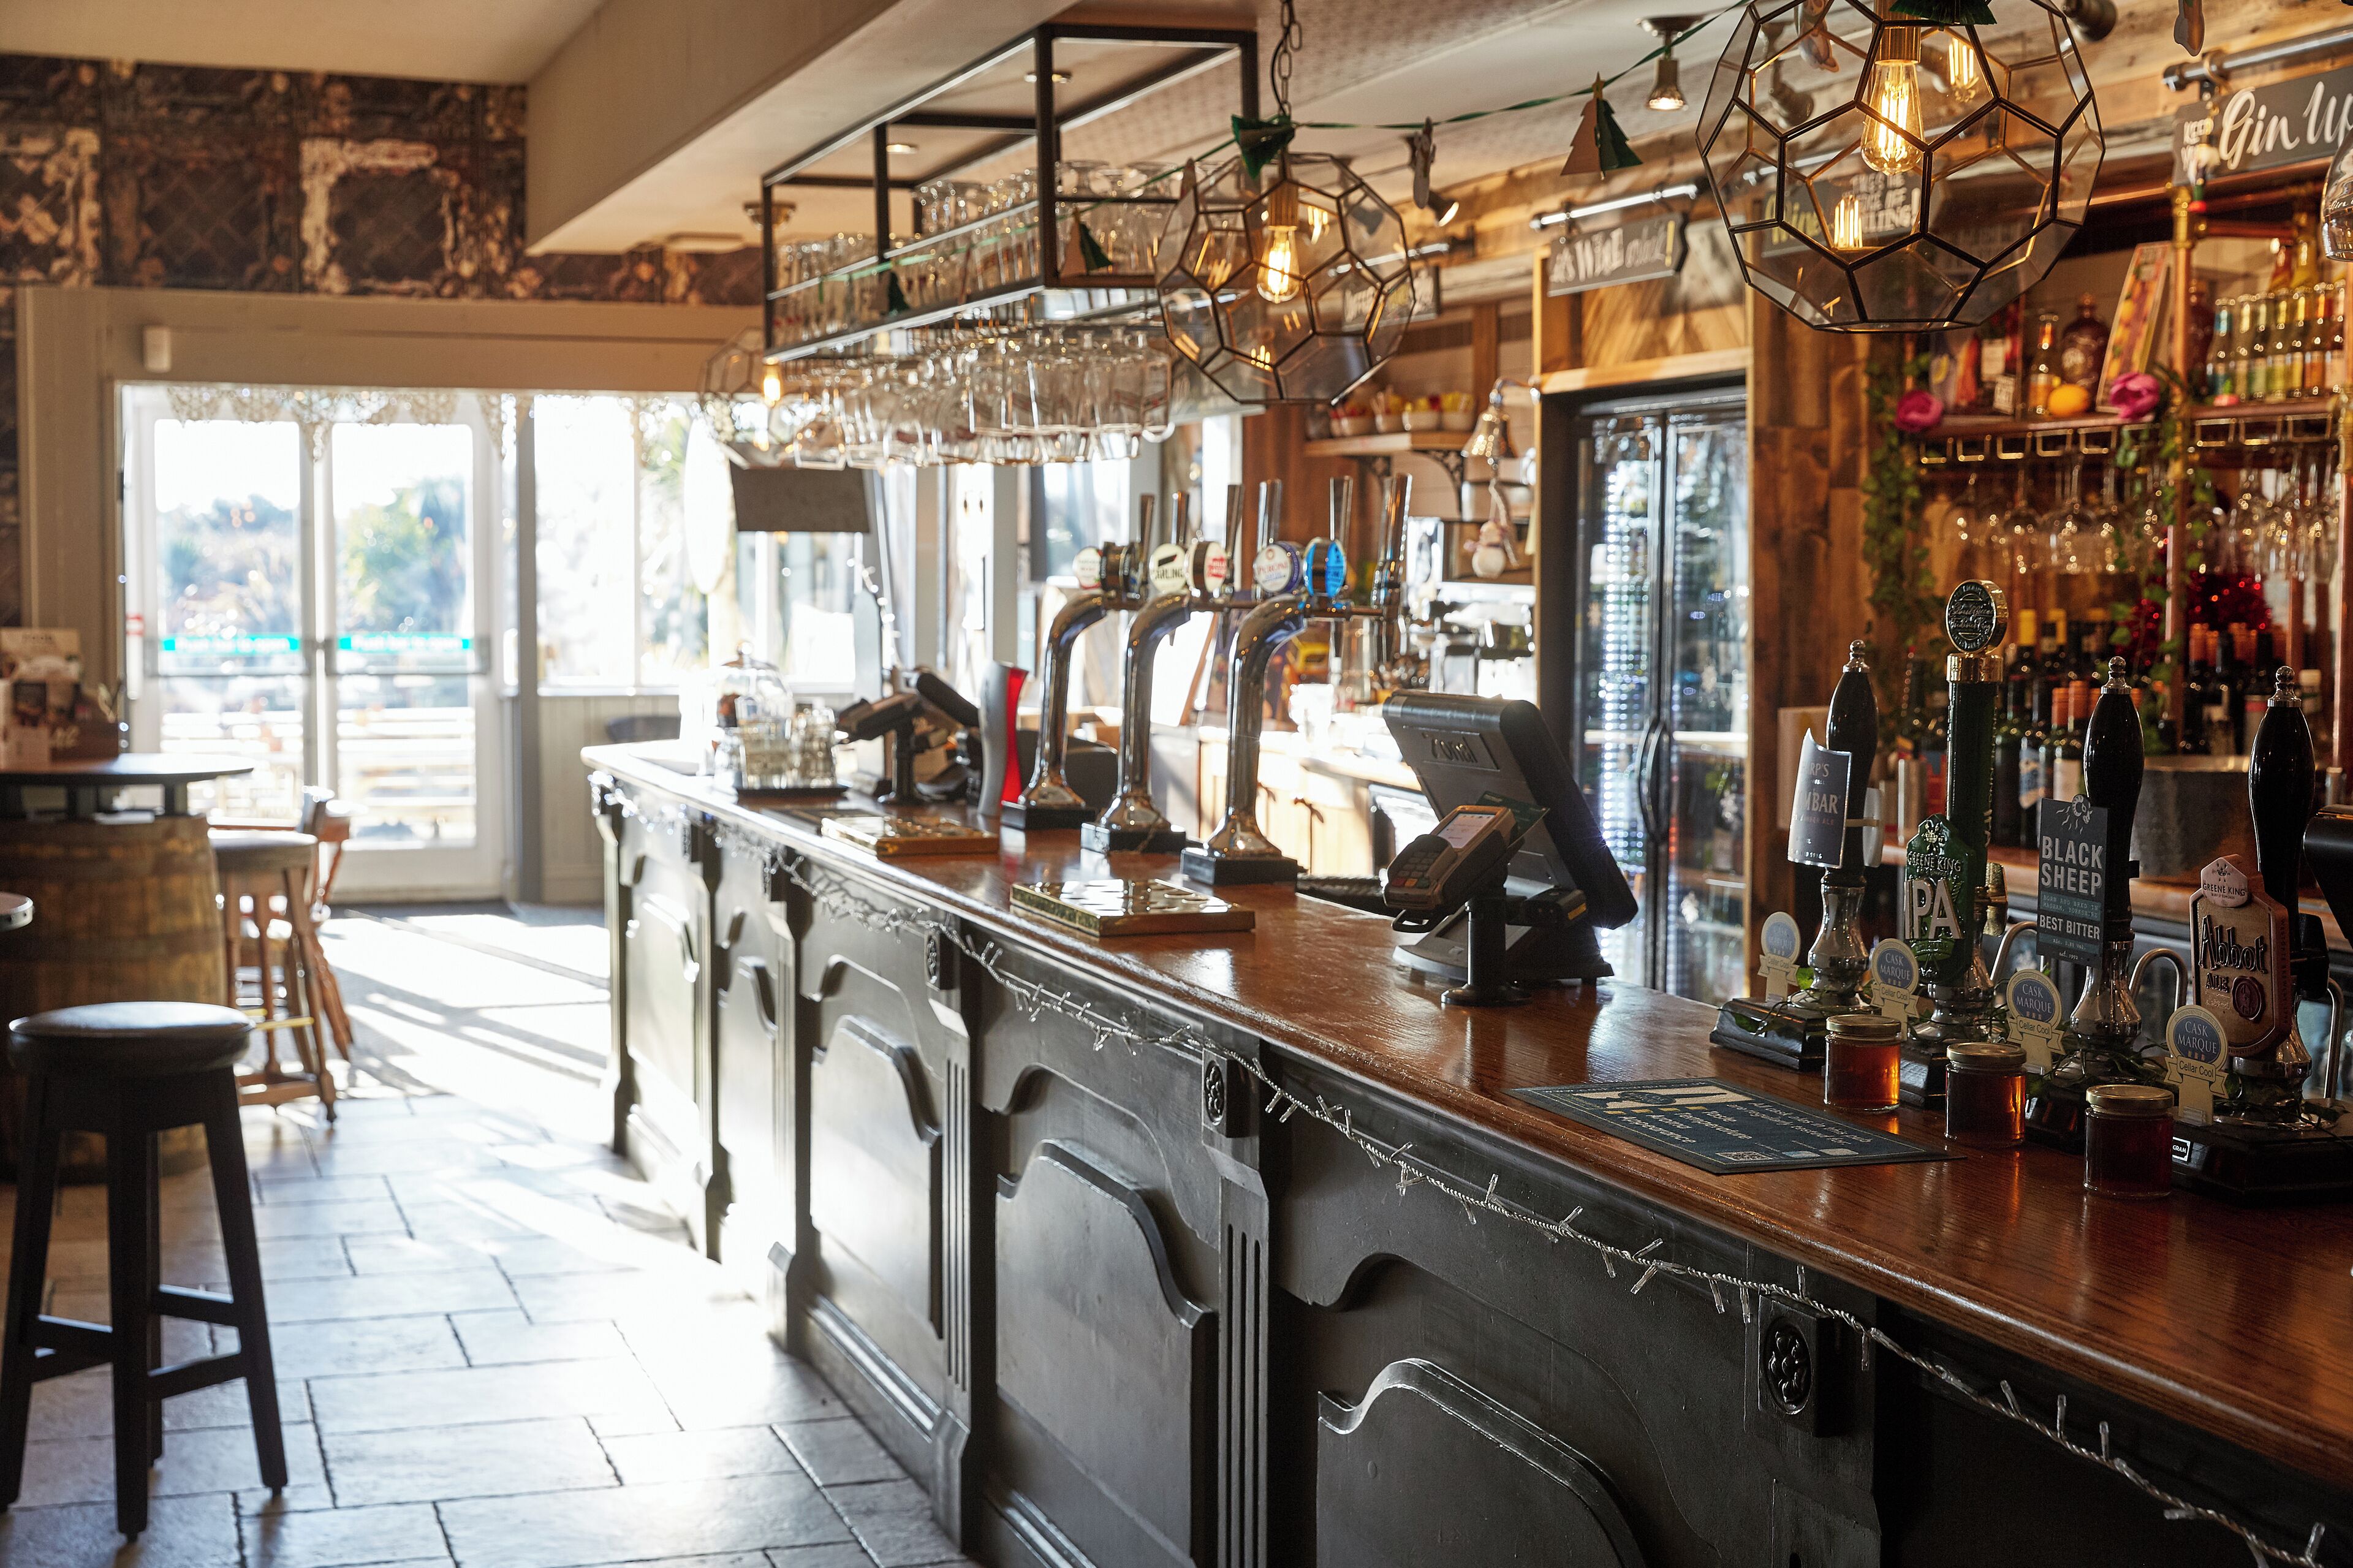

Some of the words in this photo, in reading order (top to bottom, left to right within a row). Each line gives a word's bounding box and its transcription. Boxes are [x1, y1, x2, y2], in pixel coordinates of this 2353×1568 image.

[2219, 86, 2300, 170] Gin
[1908, 850, 1935, 868] GREENE
[1937, 856, 1961, 872] KING
[2041, 835, 2104, 869] BLACK
[2040, 863, 2102, 896] SHEEP
[2203, 883, 2226, 893] GREENE
[2228, 887, 2246, 896] KING
[1904, 877, 1963, 939] IPA
[2039, 914, 2063, 931] BEST
[2066, 920, 2101, 941] BITTER
[2198, 914, 2268, 974] Abbot
[1885, 953, 1904, 966] CASK
[1880, 964, 1911, 980] MARQUE
[2022, 983, 2044, 998] CASK
[2205, 972, 2230, 993] ALE
[1881, 987, 1896, 998] Cellar
[1896, 991, 1908, 1001] Cool
[2016, 996, 2052, 1013] MARQUE
[2018, 1020, 2035, 1031] Cellar
[2036, 1024, 2050, 1035] Cool
[2184, 1021, 2208, 1037] CASK
[2177, 1034, 2217, 1054] MARQUE
[2179, 1060, 2197, 1073] Cellar
[2199, 1066, 2214, 1078] Cool
[1646, 1115, 1692, 1129] Aroma
[1702, 1110, 1737, 1123] Taste
[1618, 1116, 1697, 1143] Appearance
[1674, 1112, 1752, 1140] Temperature
[2172, 1144, 2186, 1154] GRAM
